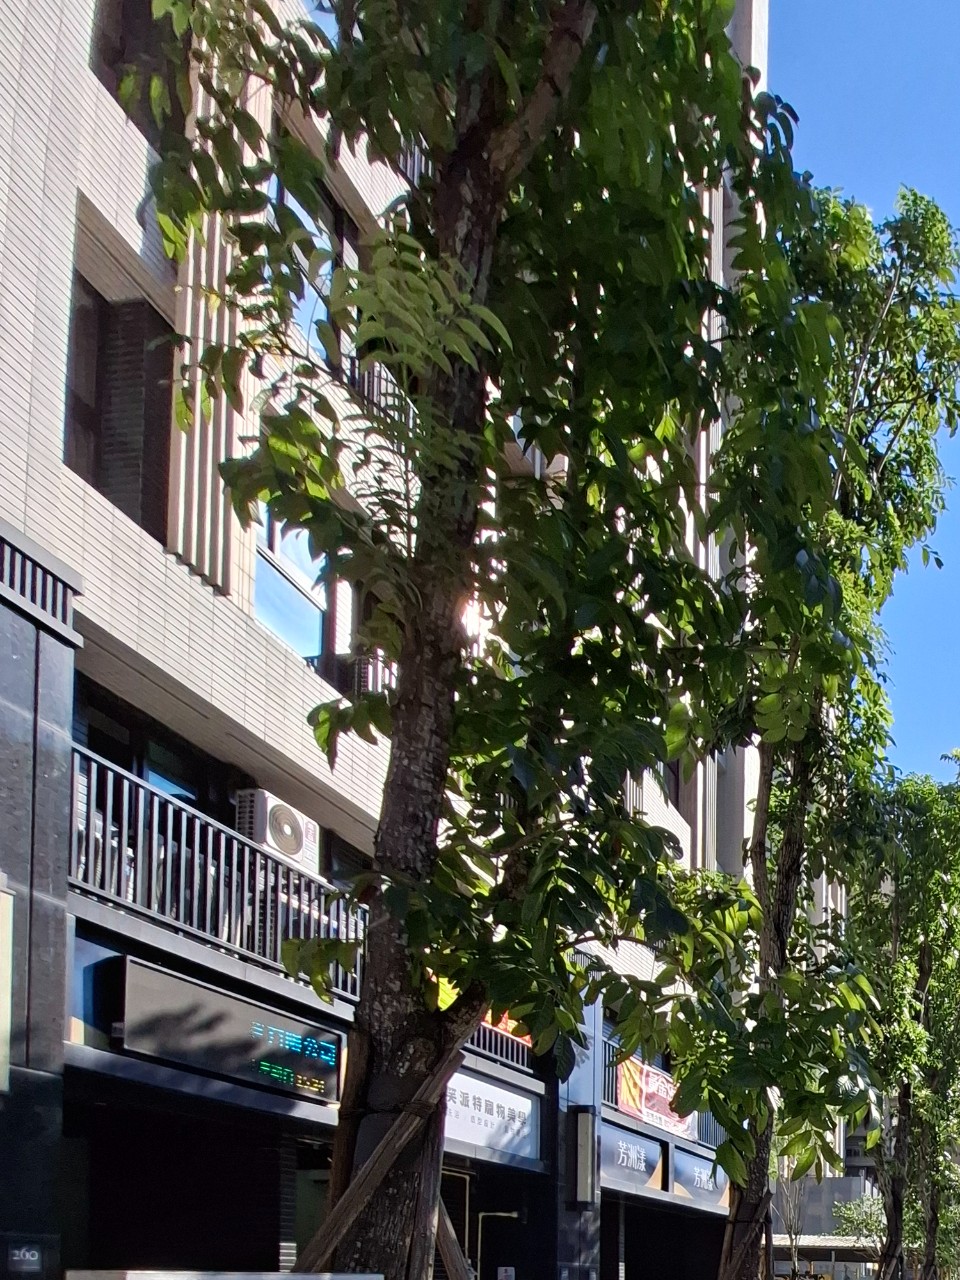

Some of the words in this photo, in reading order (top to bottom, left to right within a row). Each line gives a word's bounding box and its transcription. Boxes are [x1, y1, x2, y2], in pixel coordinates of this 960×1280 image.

[617, 1140, 646, 1172] 芳洲漾
[12, 1248, 38, 1260] 260
